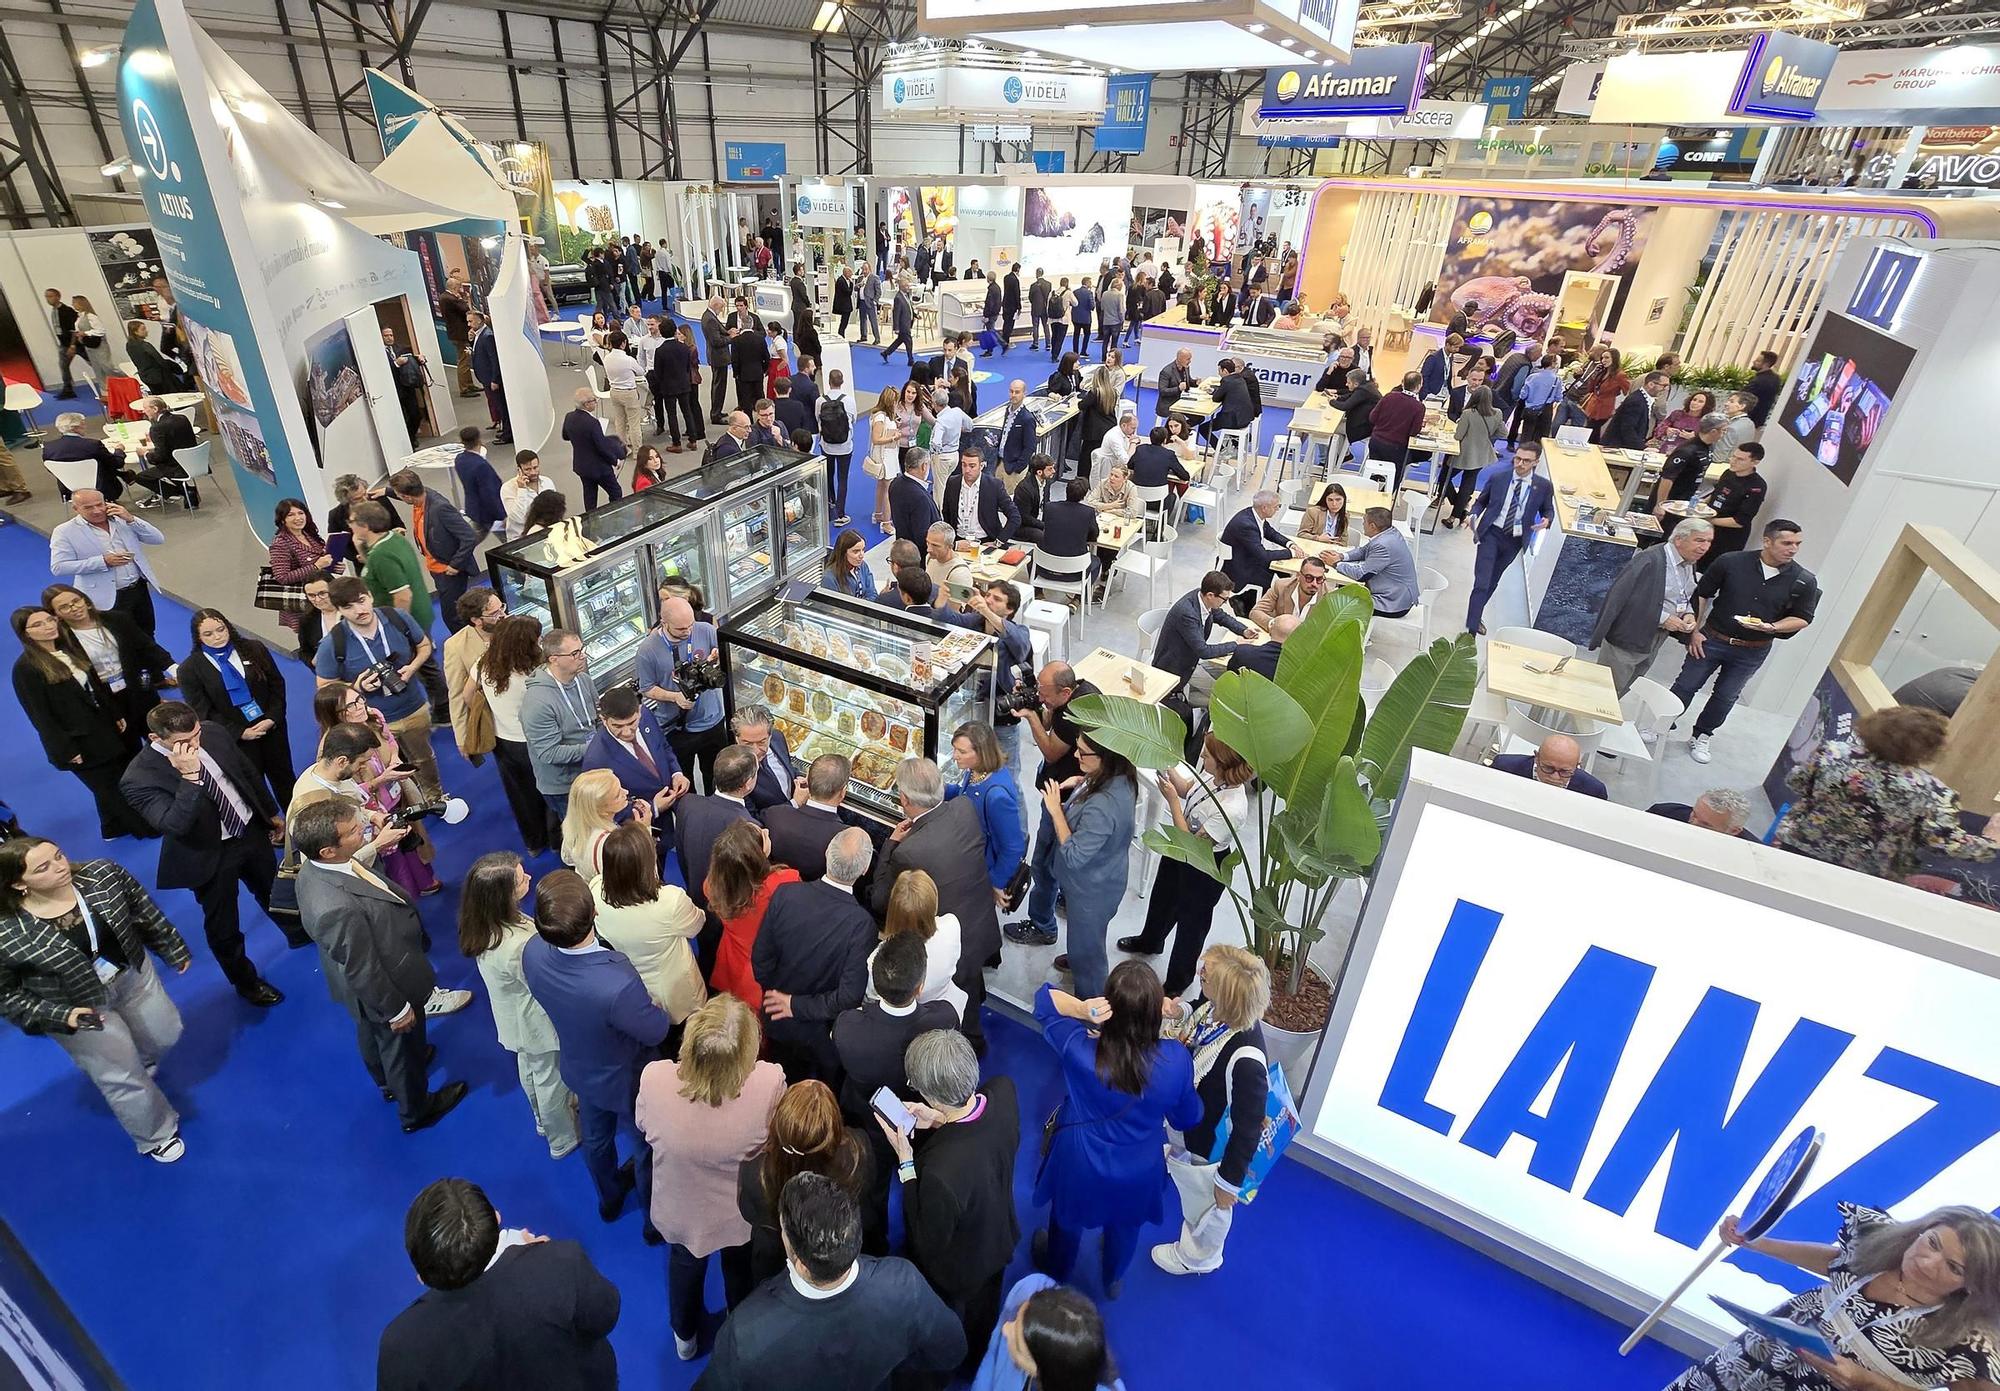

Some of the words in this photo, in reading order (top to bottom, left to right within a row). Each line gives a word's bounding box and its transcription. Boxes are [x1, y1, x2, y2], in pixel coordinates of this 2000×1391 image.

[906, 83, 935, 97] VIDELA
[1303, 71, 1399, 98] Aframar
[1777, 65, 1822, 98] Aframar
[1893, 79, 1937, 89] GROUP
[1025, 86, 1067, 99] VIDELA
[1117, 89, 1137, 106] HALL
[1139, 88, 1145, 105] 1
[1491, 86, 1511, 98] HALL
[1512, 86, 1520, 97] 3
[1116, 105, 1136, 122] HALL
[1137, 105, 1145, 122] 2
[158, 192, 193, 220] ALTIUS
[812, 202, 846, 212] VIDELA
[1378, 898, 2000, 1294] LANZ
